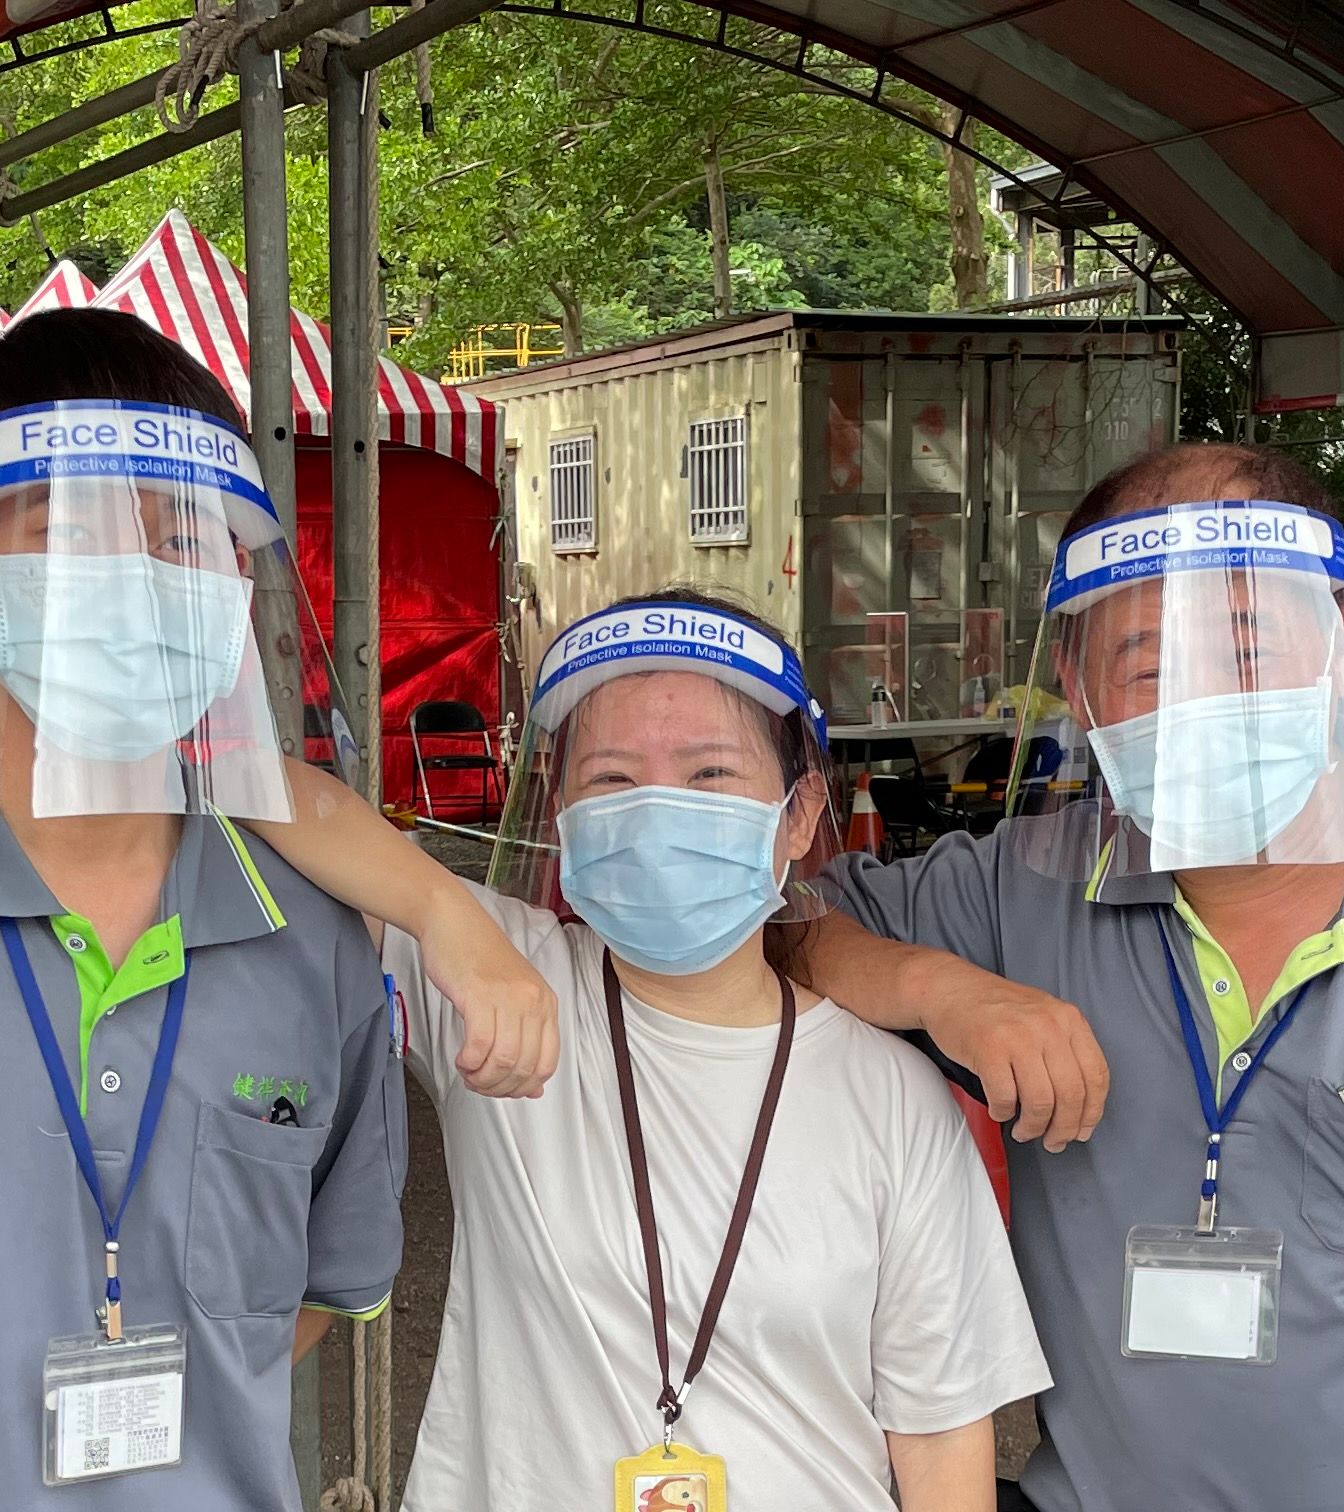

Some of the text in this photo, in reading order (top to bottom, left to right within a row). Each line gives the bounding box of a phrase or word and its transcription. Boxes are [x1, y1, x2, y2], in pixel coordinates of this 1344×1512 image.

[20, 418, 239, 468] Face Shield
[34, 457, 234, 489] Protective Isolation Mask
[1100, 516, 1298, 561] Face Shield
[1109, 549, 1290, 580] Protective Isolation Mask
[562, 612, 745, 660] Face Shield
[567, 641, 733, 673] Protective Isolation Mask
